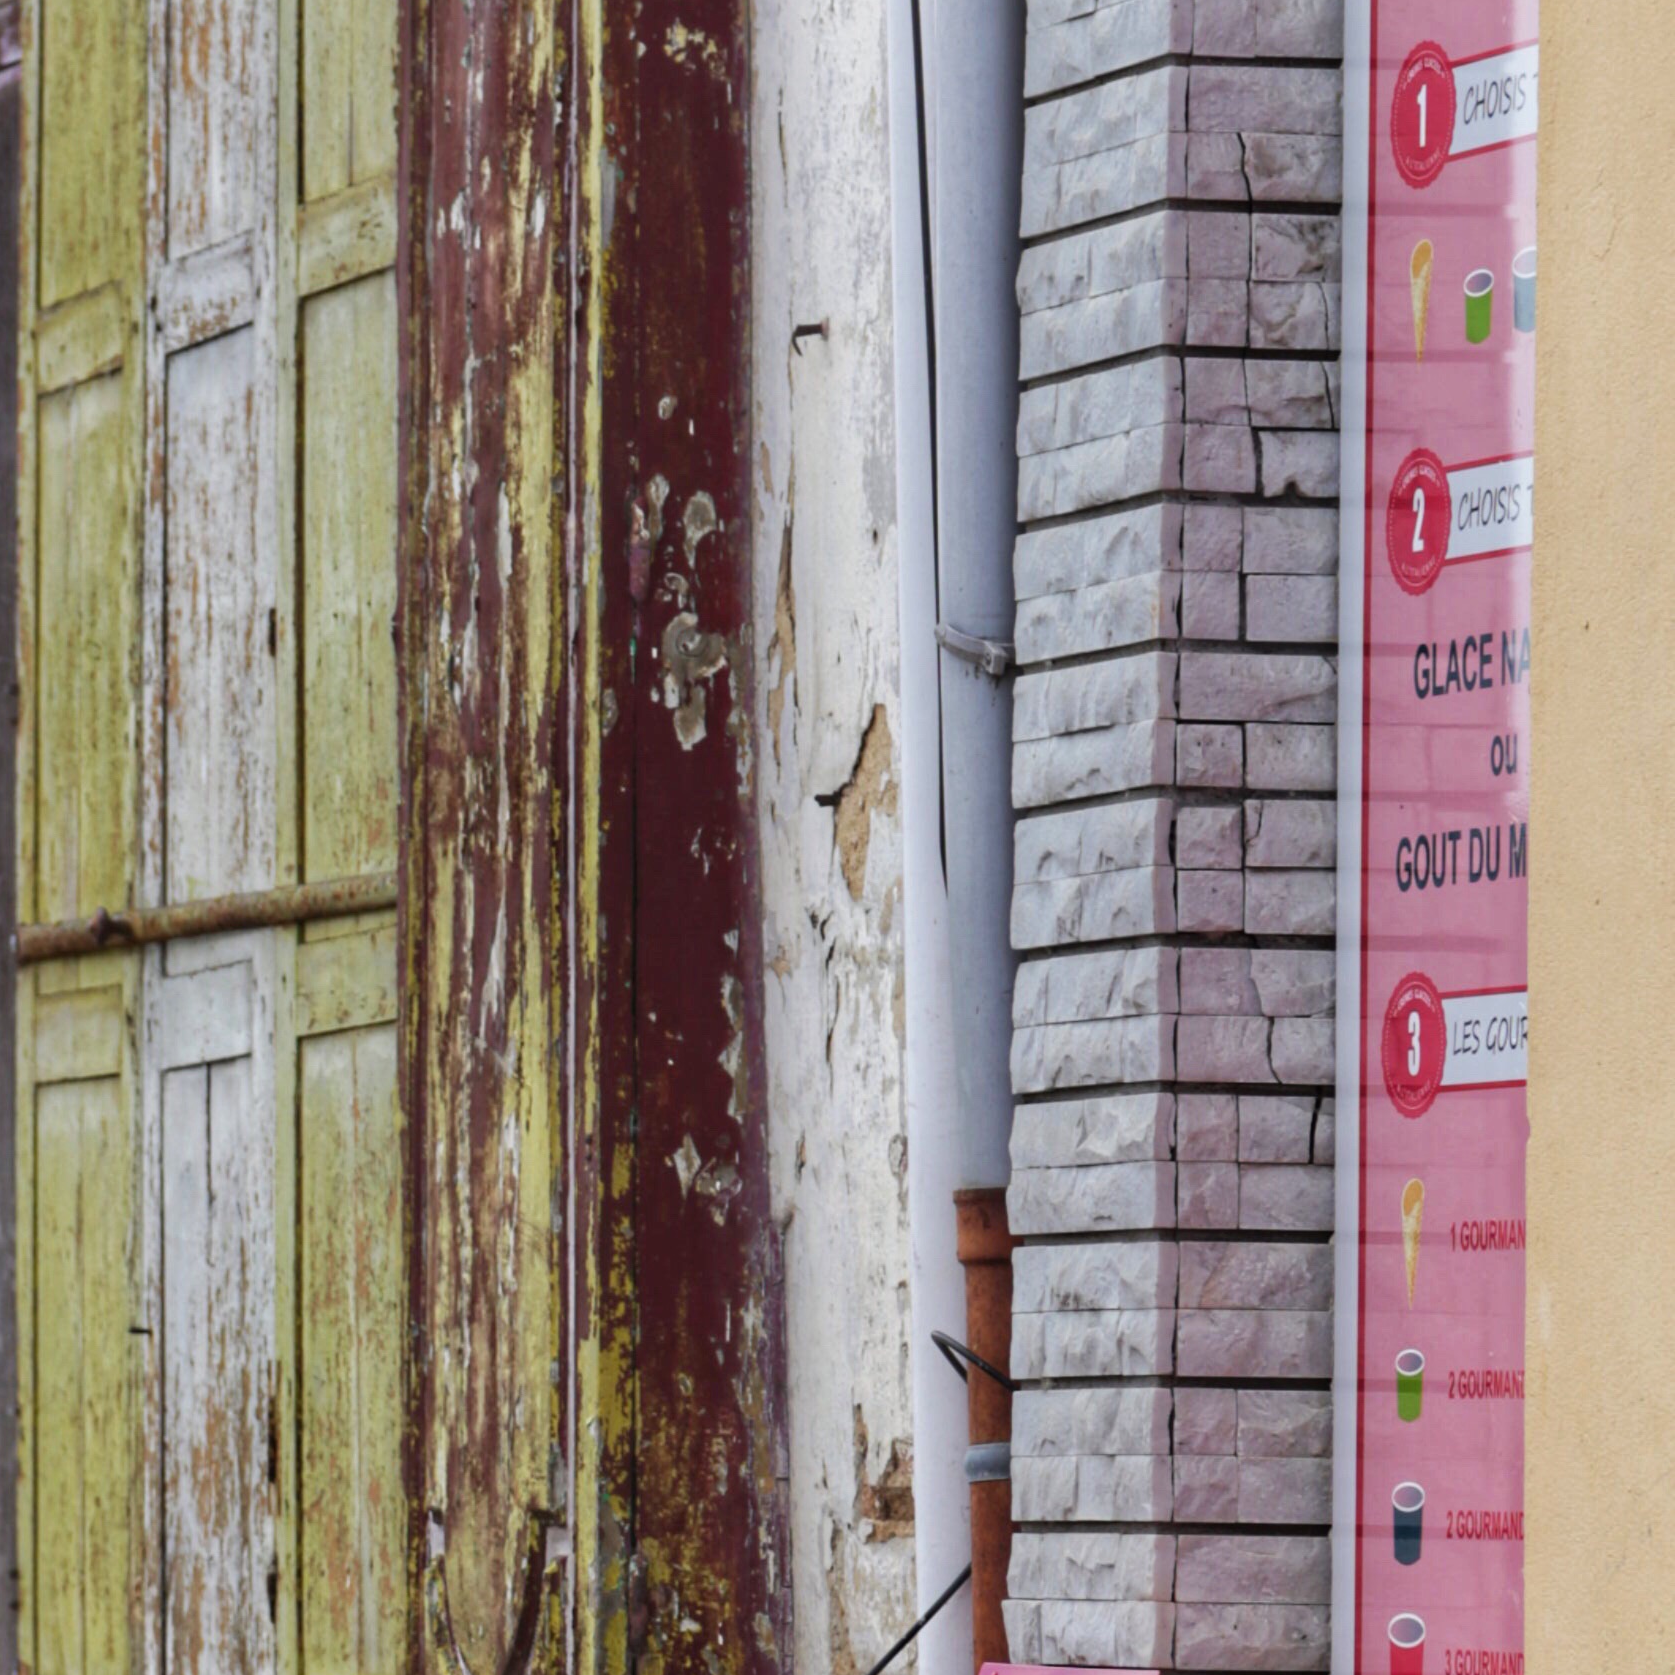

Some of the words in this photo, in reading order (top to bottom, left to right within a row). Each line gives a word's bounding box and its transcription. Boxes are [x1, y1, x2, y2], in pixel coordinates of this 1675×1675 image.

[1417, 84, 1427, 147] 1
[1464, 73, 1526, 125] CHOISIS
[1412, 487, 1425, 553] 2
[1458, 484, 1521, 530] CHOISIS
[1414, 633, 1493, 699] GLACE
[1491, 734, 1517, 776] OU
[1396, 830, 1461, 892] GOUT
[1469, 825, 1500, 883] DU
[1408, 1011, 1420, 1076] 3
[1453, 1019, 1481, 1056] LES
[1451, 1222, 1456, 1252] 1
[1448, 1371, 1455, 1399] 2
[1446, 1510, 1453, 1539] 2
